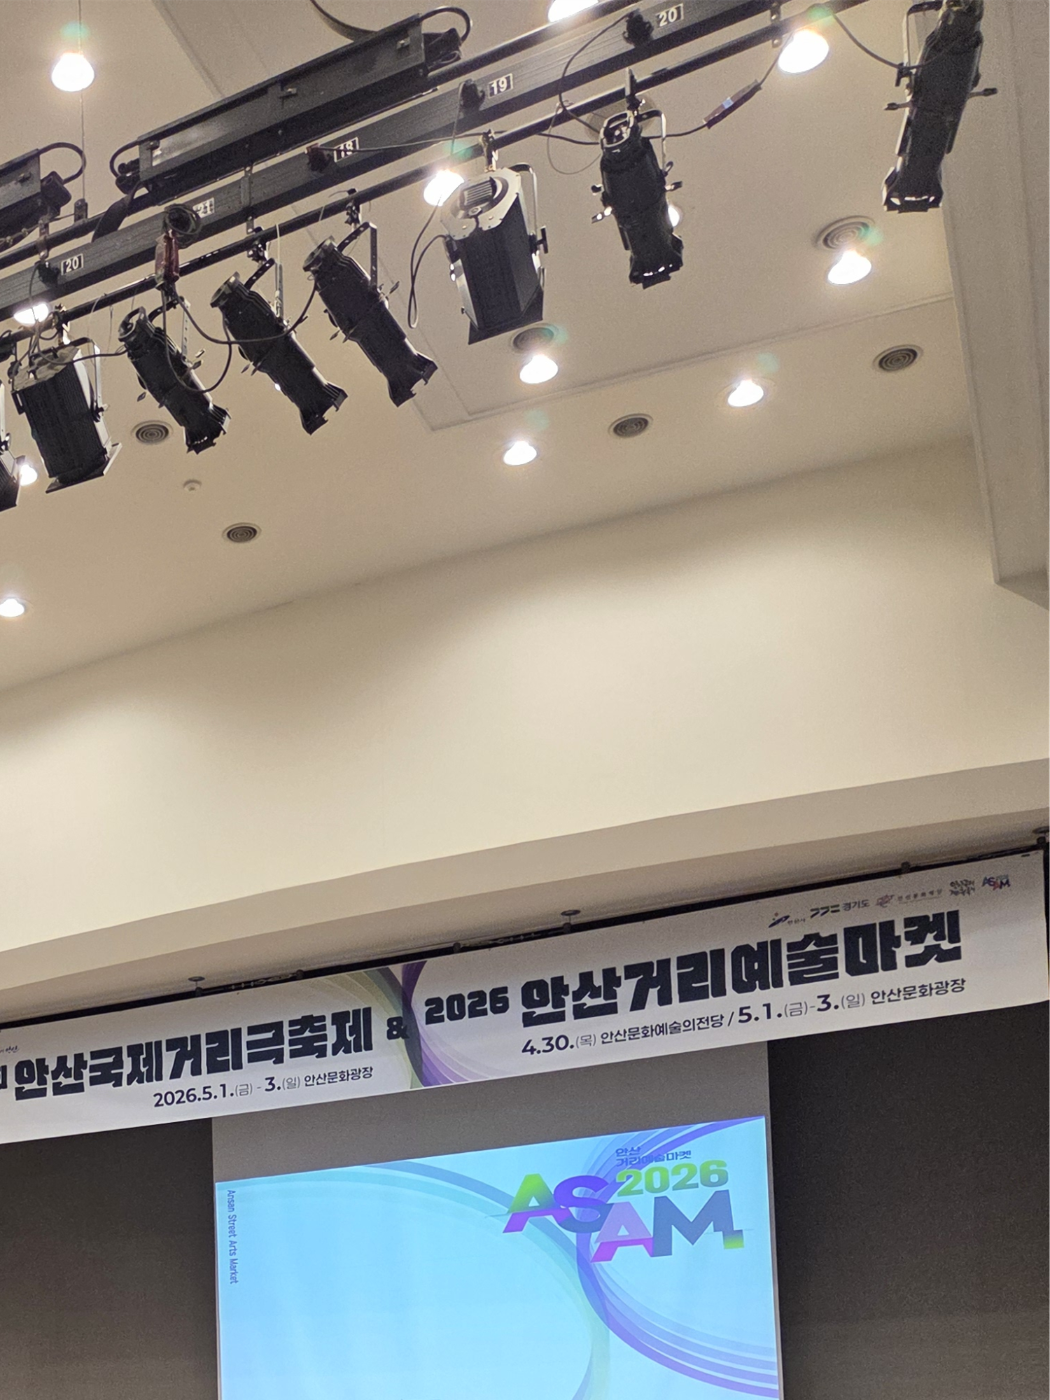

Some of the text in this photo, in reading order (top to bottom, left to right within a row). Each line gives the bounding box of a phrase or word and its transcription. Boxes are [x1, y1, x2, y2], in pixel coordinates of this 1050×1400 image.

[658, 8, 678, 27] 20
[491, 77, 507, 96] 19
[65, 258, 80, 272] 20
[842, 899, 870, 912] 경기도
[424, 908, 963, 1028] 2026 안산거리예술마켓
[521, 1033, 597, 1056] 4.30.(목)
[600, 1013, 725, 1045] 안산문화예술의전당
[870, 977, 967, 1005] 안산문화광장
[15, 1006, 374, 1101] 안산국제거리극축제
[386, 1016, 411, 1041] &
[264, 1075, 301, 1093] 3.(일)
[304, 1066, 374, 1087] 안산문화광장
[615, 1146, 641, 1157] 안산
[616, 1150, 692, 1167] 거리예술마켓
[616, 1160, 729, 1197] 2026
[502, 1173, 745, 1263] ASAM
[227, 1189, 239, 1285] Ansan Street Arts Market
